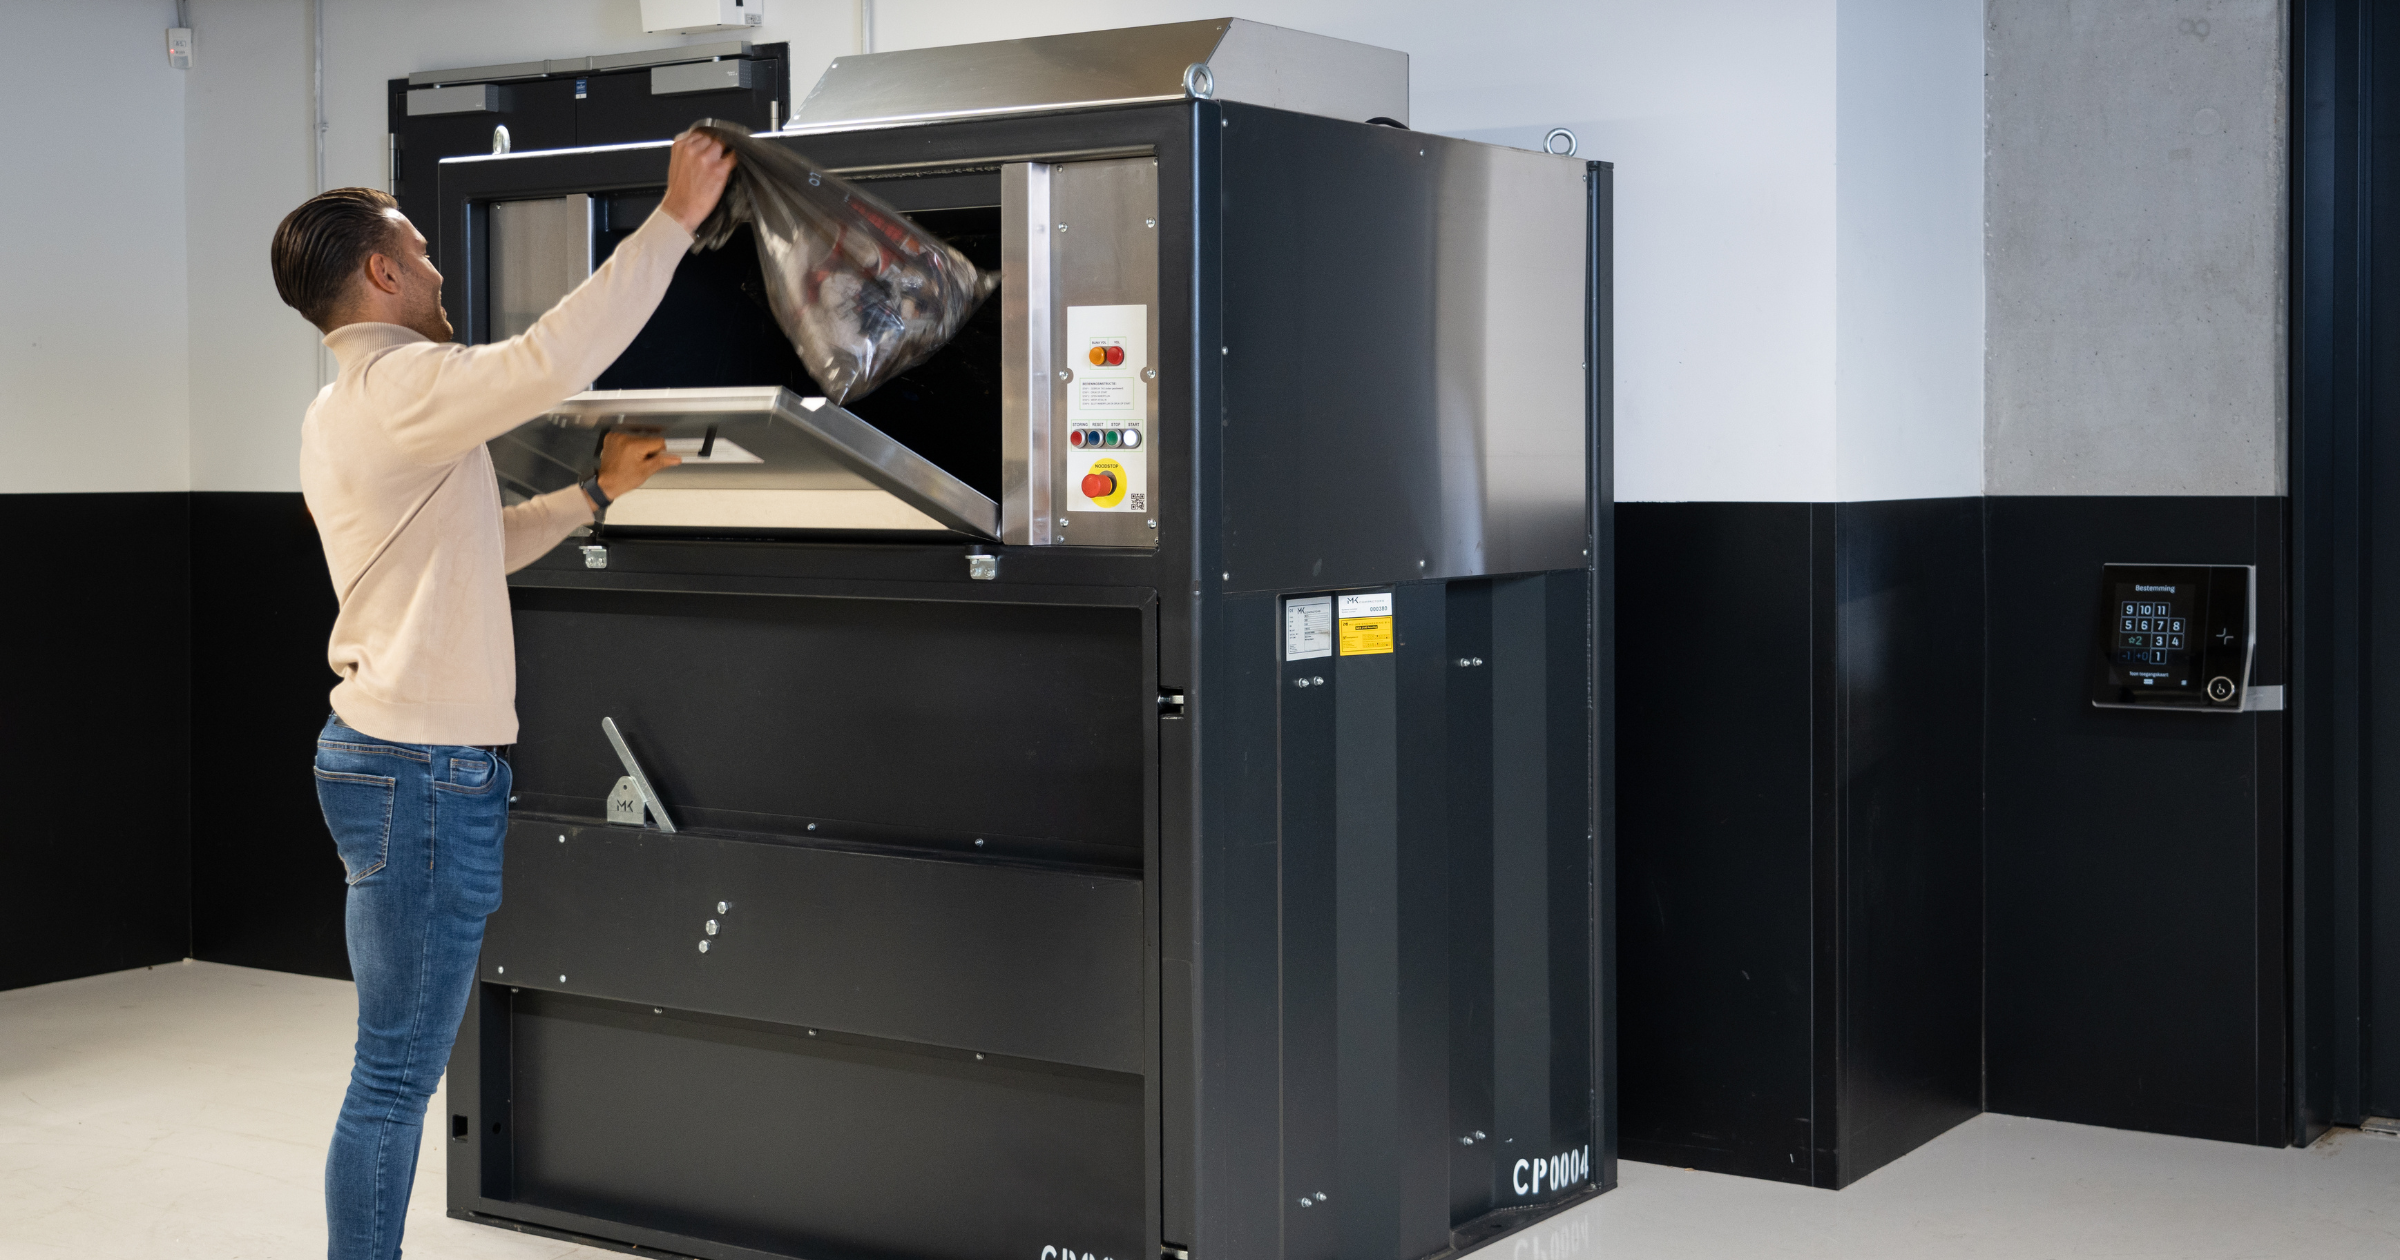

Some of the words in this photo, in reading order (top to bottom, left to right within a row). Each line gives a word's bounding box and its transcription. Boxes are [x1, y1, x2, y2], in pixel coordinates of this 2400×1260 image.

[2135, 584, 2176, 593] Bestemming
[2126, 605, 2133, 615] 9
[2140, 605, 2151, 615] 10
[2157, 606, 2166, 615] 11
[2125, 620, 2132, 630] 5
[2141, 620, 2148, 630] 6
[2157, 621, 2164, 630] 7
[2173, 622, 2180, 631] 8
[2135, 636, 2142, 645] 2
[2156, 637, 2163, 646] 3
[2171, 637, 2179, 646] 4
[2122, 651, 2131, 660] -1
[2155, 651, 2160, 661] 1
[617, 799, 633, 813] MK
[1513, 1144, 1589, 1196] CP0004
